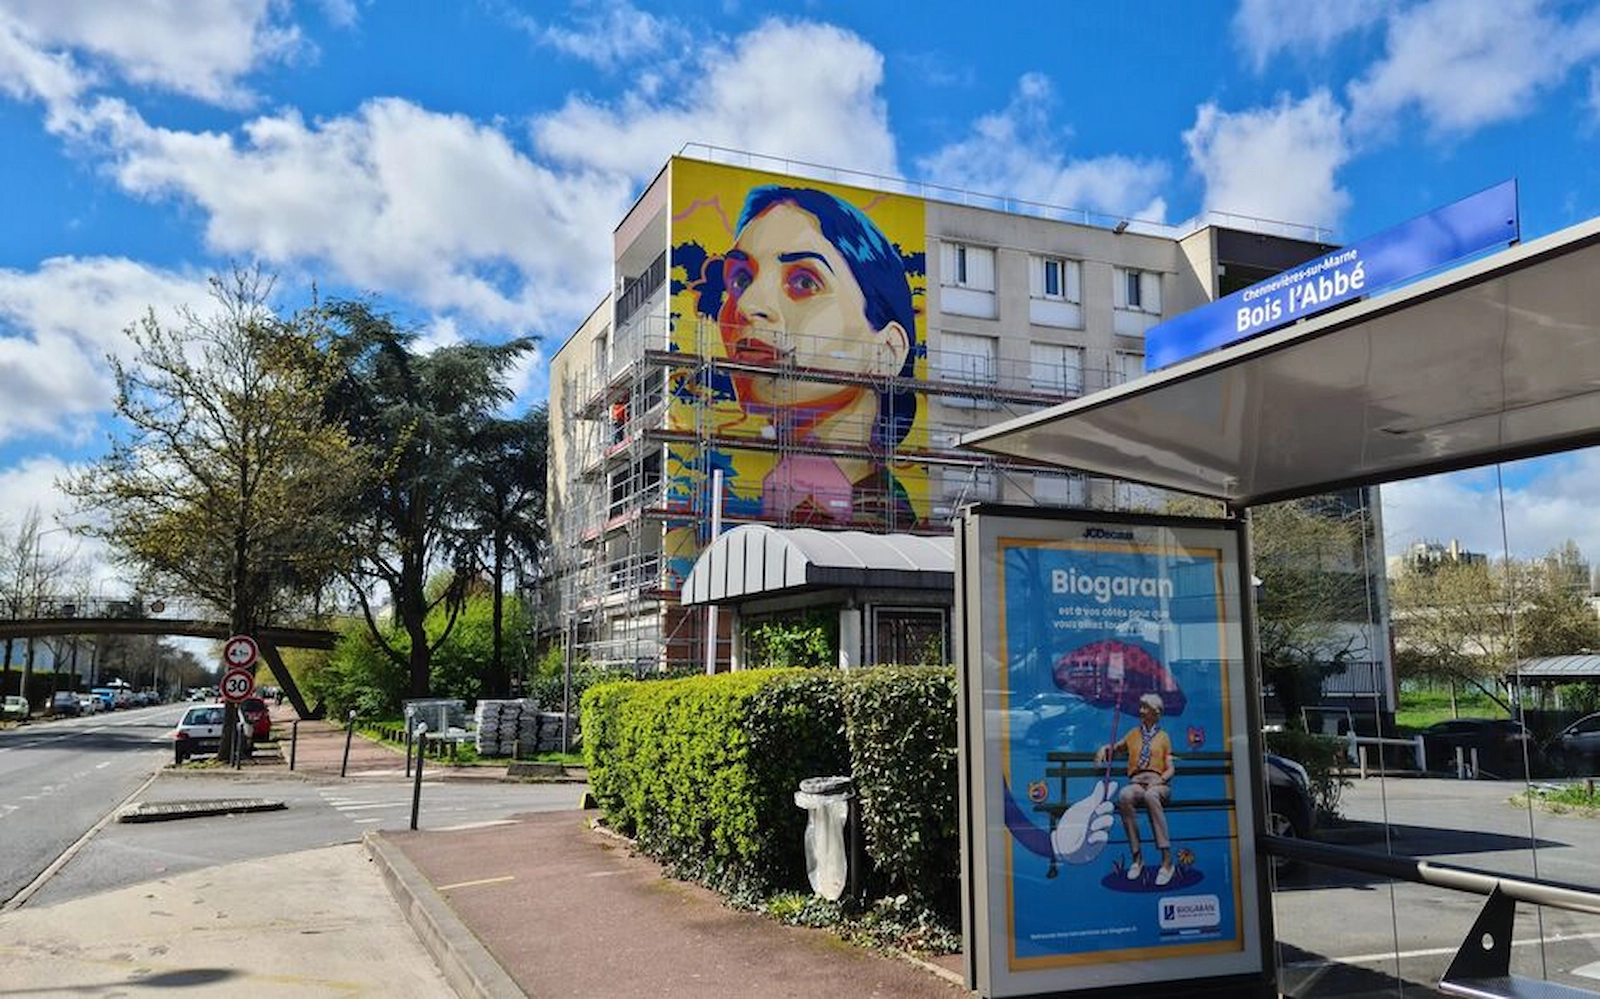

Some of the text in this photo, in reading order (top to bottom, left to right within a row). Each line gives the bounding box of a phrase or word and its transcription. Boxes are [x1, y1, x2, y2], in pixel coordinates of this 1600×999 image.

[1243, 249, 1357, 302] Chennevières-sur-Marne
[1237, 298, 1282, 332] Bois
[1051, 568, 1174, 603] Biogaran
[1083, 608, 1099, 617] vos
[228, 679, 247, 692] 30
